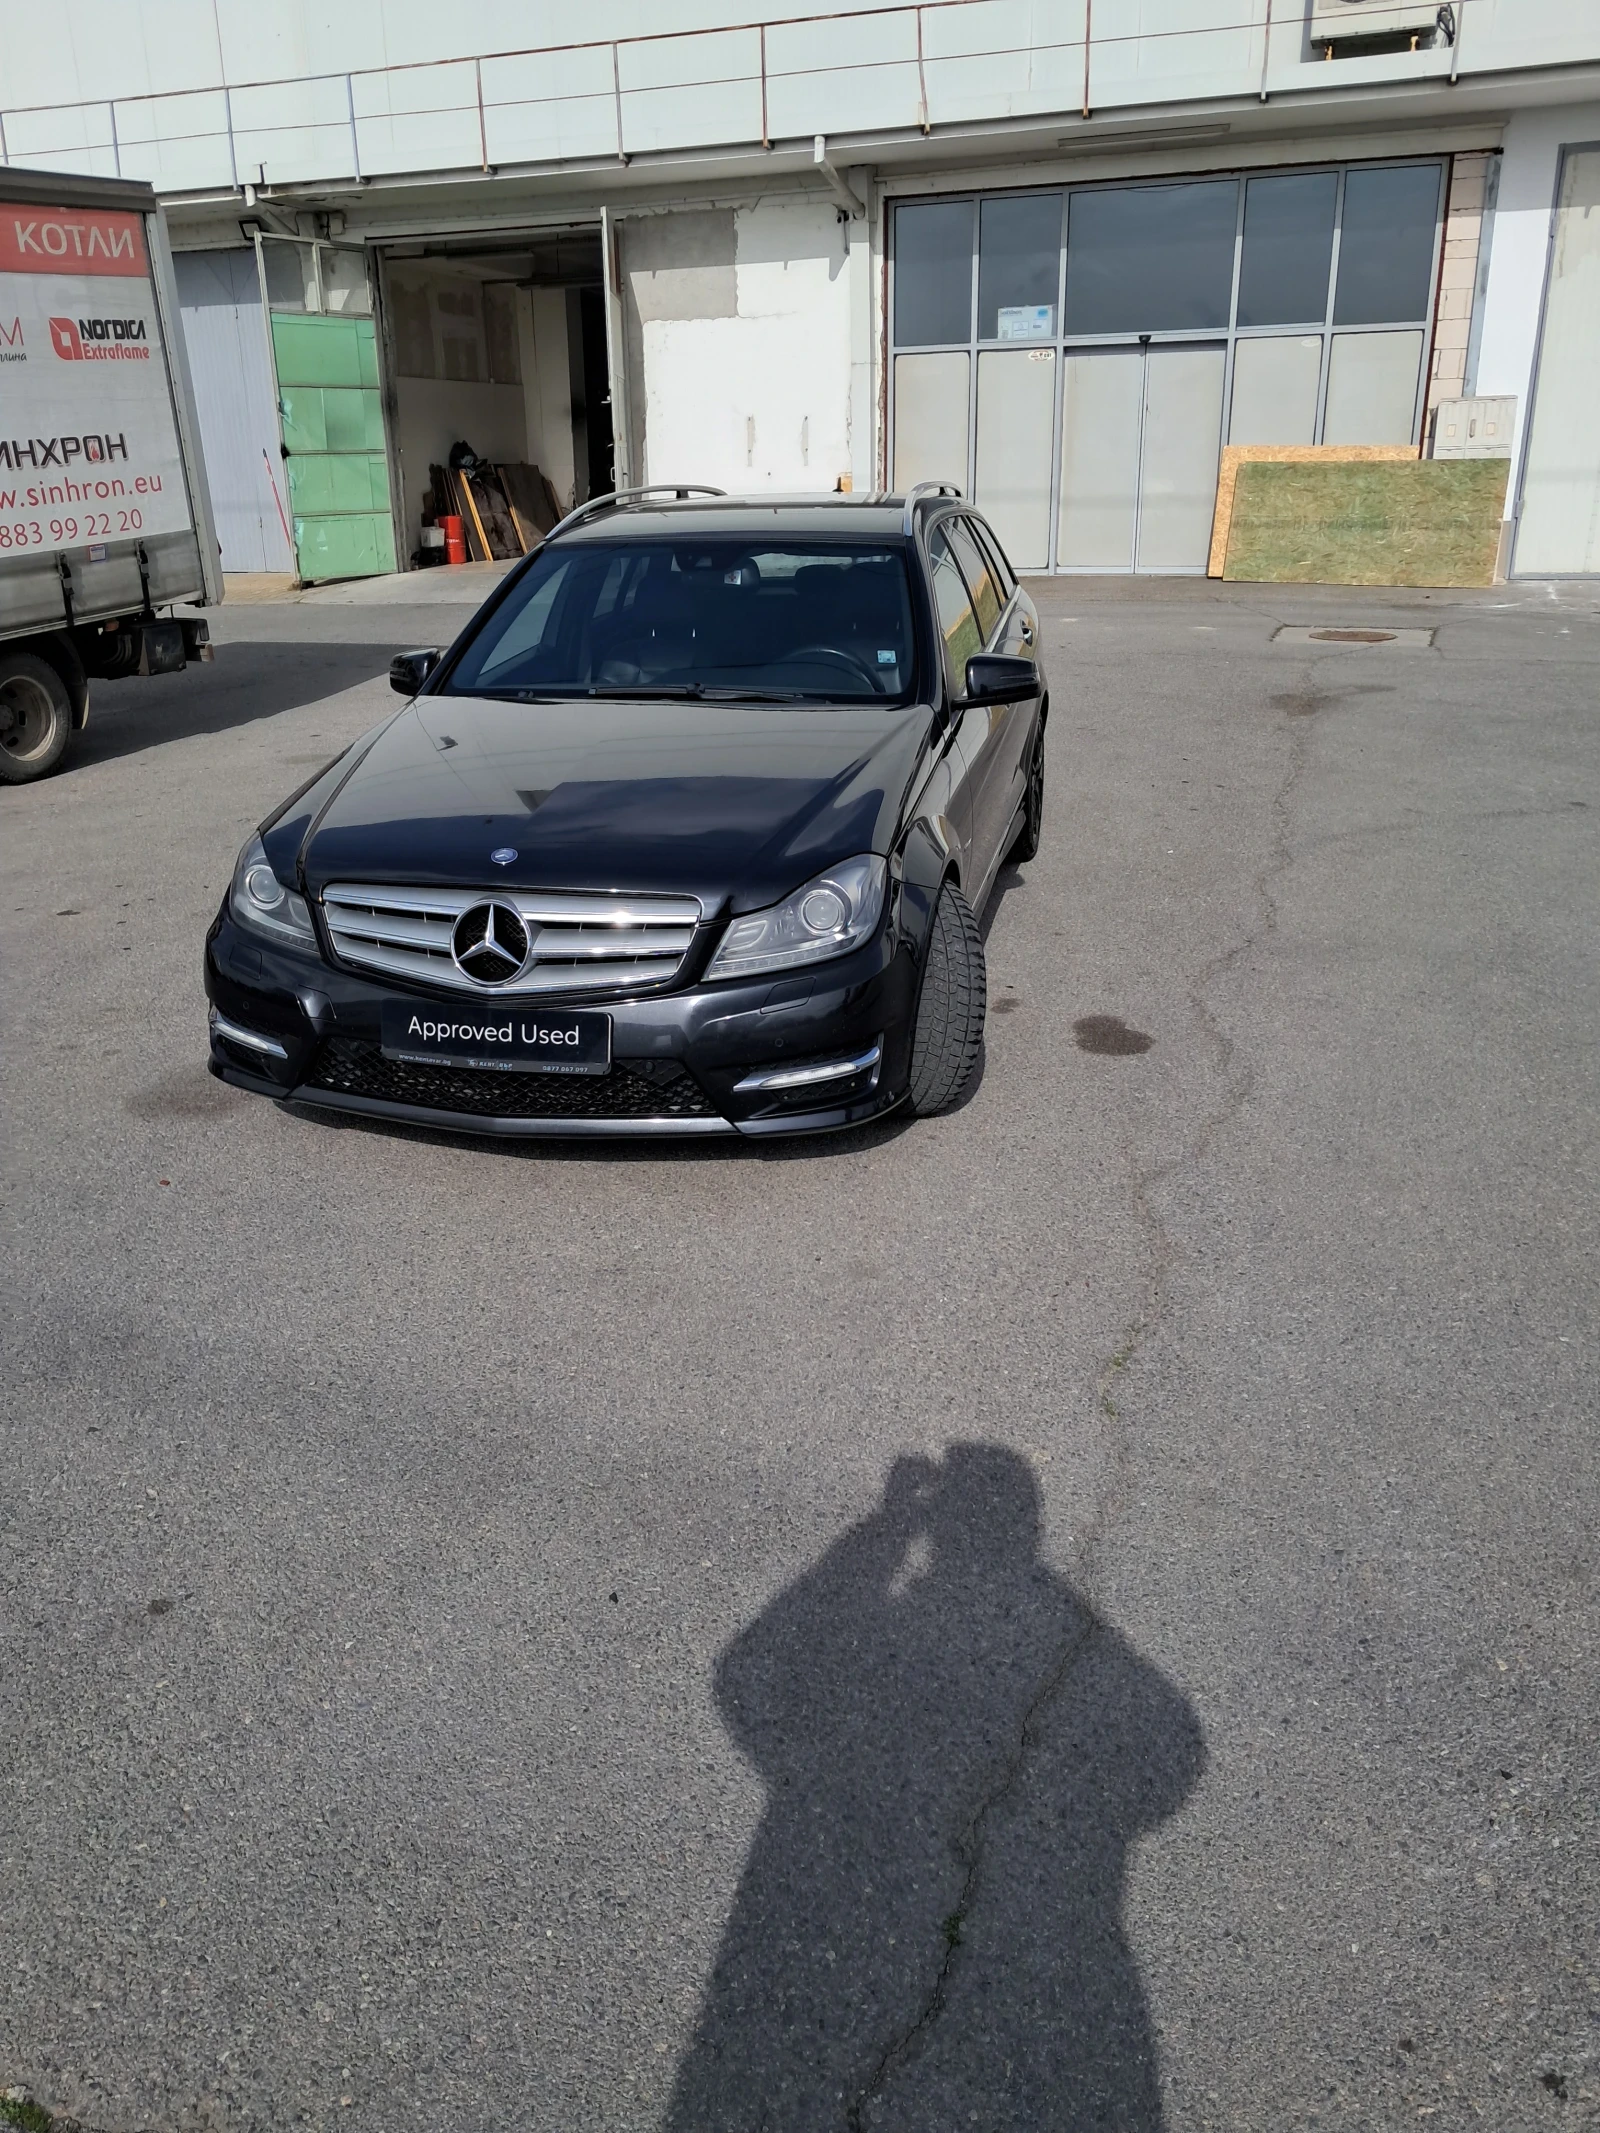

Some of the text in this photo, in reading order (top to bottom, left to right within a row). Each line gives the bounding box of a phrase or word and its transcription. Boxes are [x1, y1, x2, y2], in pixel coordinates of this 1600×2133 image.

[14, 220, 135, 258] КОТЛИ
[82, 343, 150, 360] Extraflame
[50, 517, 78, 541] 99
[84, 514, 111, 537] 22
[117, 508, 143, 532] 20
[408, 1016, 580, 1045] Approved Used
